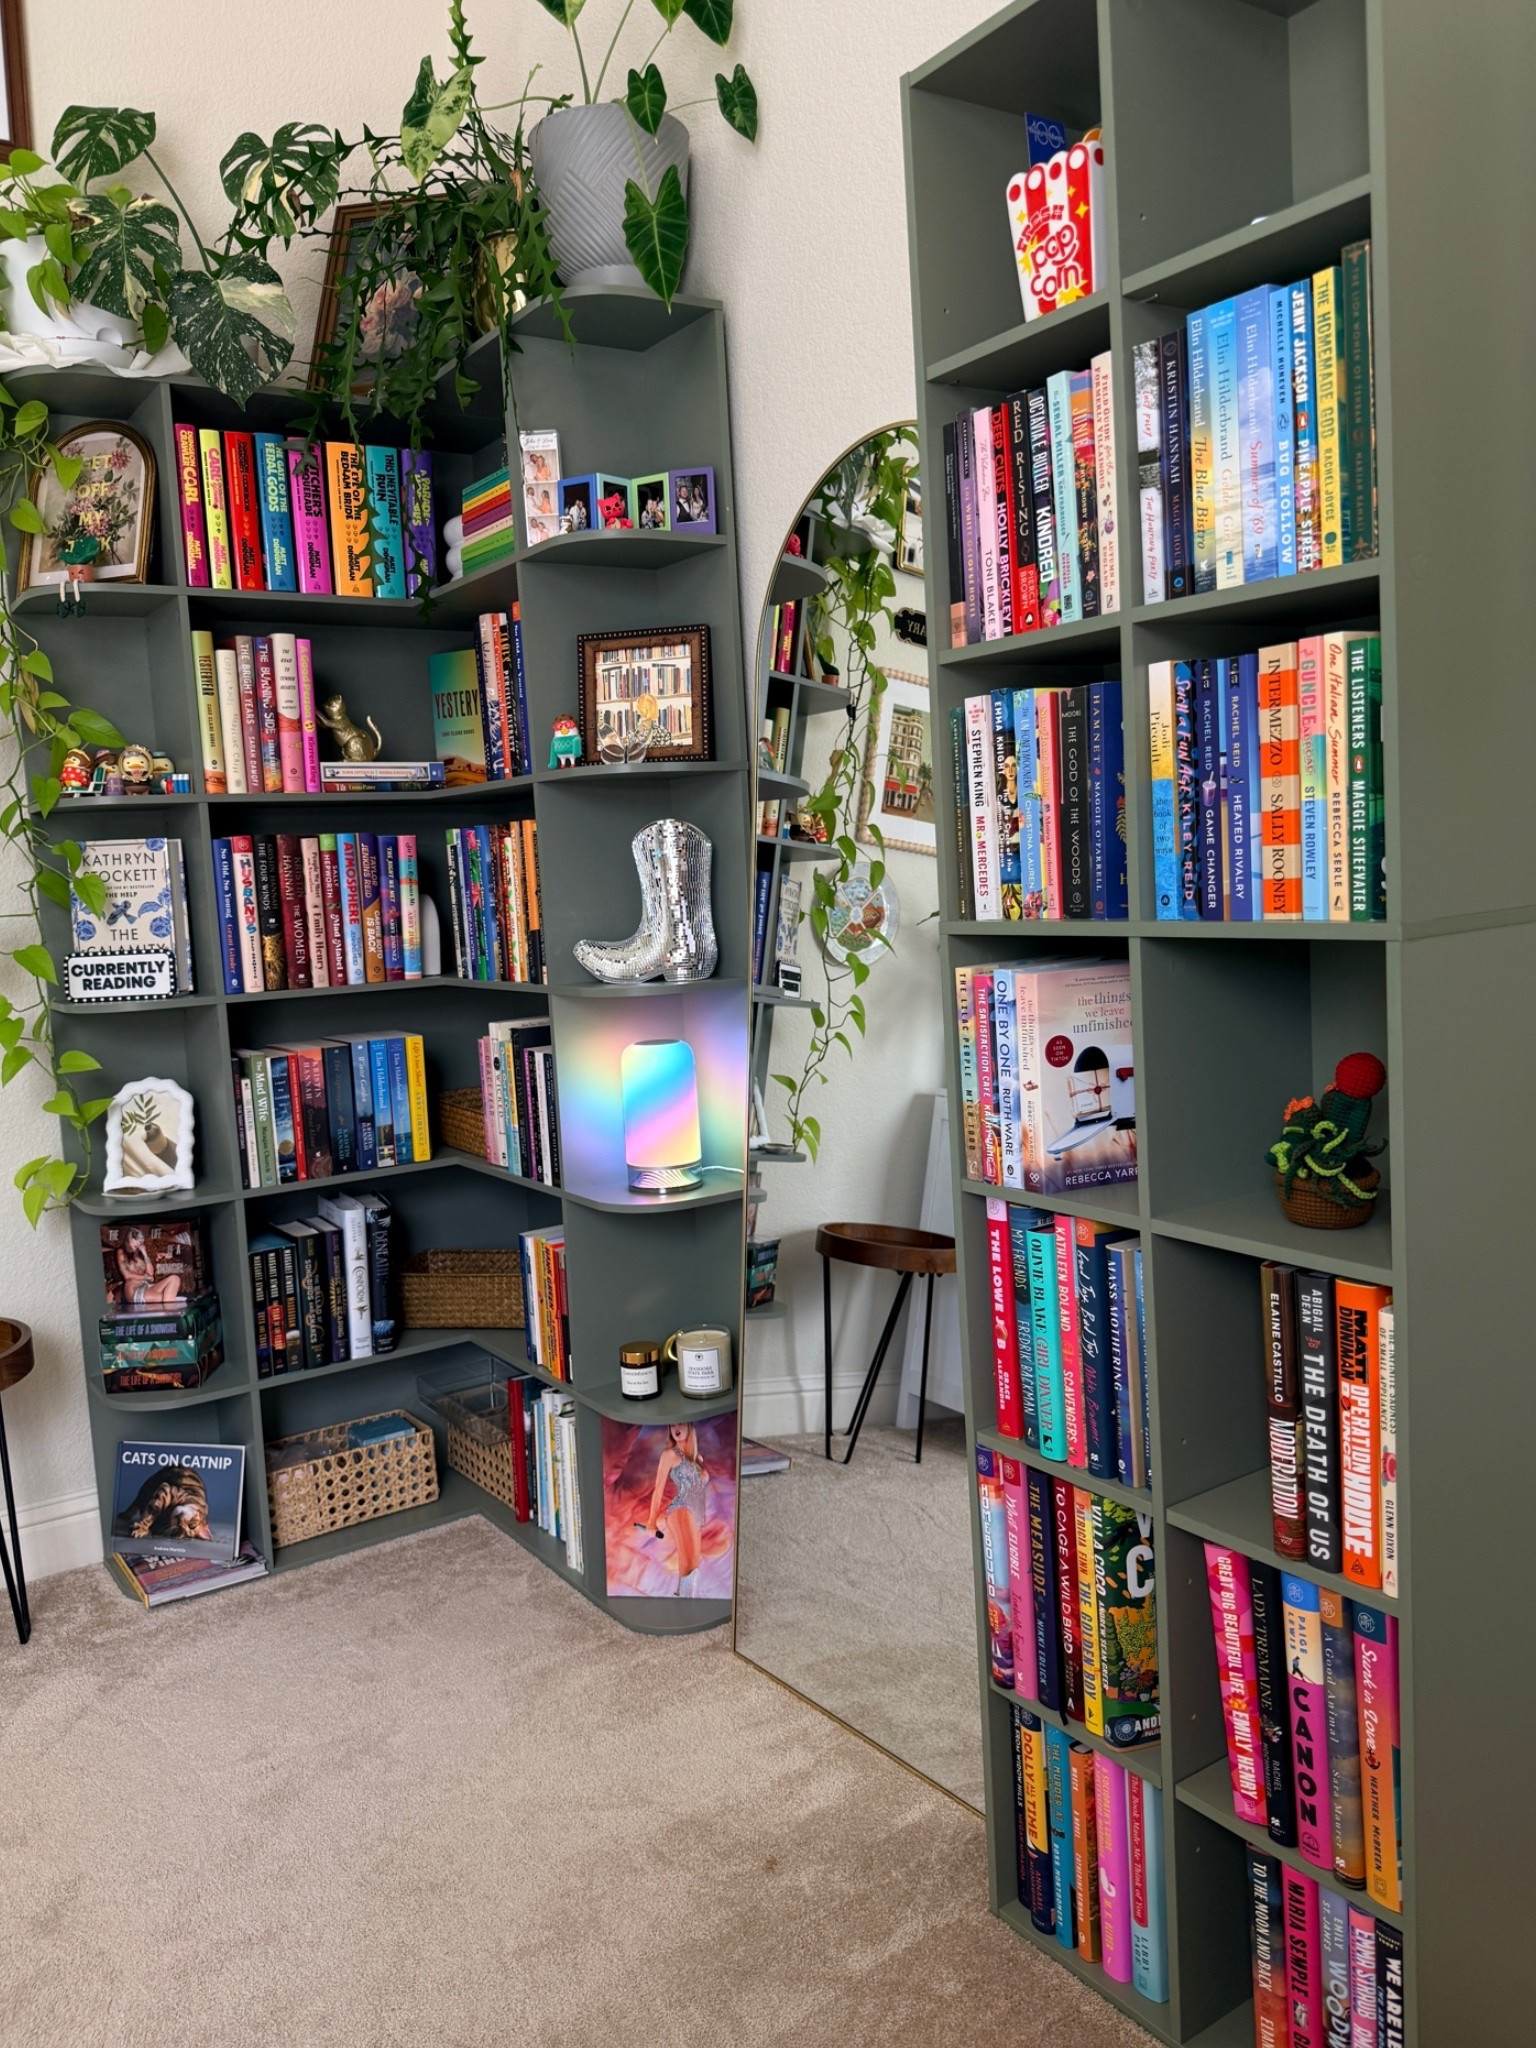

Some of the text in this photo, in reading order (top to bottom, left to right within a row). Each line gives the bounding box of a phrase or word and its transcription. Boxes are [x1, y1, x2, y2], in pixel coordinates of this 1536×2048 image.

[1017, 204, 1065, 252] FRESH
[1030, 224, 1076, 273] pop
[1030, 265, 1081, 298] corn
[1315, 280, 1336, 439] THE HOMEMADE GOD
[1166, 360, 1183, 484] KRISTIN HANNAH
[1191, 319, 1209, 550] Elin Hilderbrand The Blue Bistro
[1292, 290, 1312, 572] JENNY JACKSON PINEAPPLE STREET
[77, 482, 112, 499] OFF
[183, 466, 198, 506] CARL
[264, 442, 279, 513] FERAL GODS
[344, 490, 354, 521] BRIDE
[374, 473, 386, 502] RUIN
[1012, 400, 1029, 537] RED RISING
[1279, 440, 1293, 564] BUG HOLLOW
[65, 536, 112, 553] JK
[78, 510, 105, 526] MY
[991, 412, 1012, 623] DEEP CUTS HOLLY BRICKLEY
[1036, 508, 1054, 583] KINDRED
[985, 549, 995, 625] TONI BLAKE
[1019, 571, 1028, 610] BROWN
[1026, 570, 1035, 606] PIERCE
[240, 643, 255, 726] THE BRIGHT YEARS
[1231, 695, 1240, 768] RACHEL REID
[1327, 643, 1342, 888] One Italian Summer REBECCA SERLE
[971, 729, 989, 897] STEPHEN KING MERCEDES
[1067, 726, 1080, 885] THE GOD OF THE WOODS
[1268, 657, 1286, 914] INTERMEZZO SALLY ROONEY
[1351, 648, 1367, 912] THE LISTENERS MAGGIE STIEFVATER
[82, 852, 156, 867] KATHRYN
[1025, 800, 1035, 889] CHRISTINA LAUREN
[1205, 809, 1217, 909] GAME CHANGER
[1233, 795, 1245, 900] HEATED RIVALRY
[1304, 786, 1316, 880] STEVEN ROWLEY
[258, 842, 269, 912] THE FOUR WINDS
[342, 841, 360, 926] ATMOSPHERE
[70, 960, 166, 977] CURRENTLY
[110, 928, 139, 941] THE
[294, 919, 306, 965] WOMEN
[313, 913, 324, 971] Emily Henry
[82, 975, 156, 991] READING
[1077, 991, 1131, 1007] the things
[1085, 1007, 1125, 1018] we leave
[254, 1072, 267, 1122] Mad Wife
[996, 980, 1014, 1157] ONE BY ONE RUTH WARE
[1065, 1170, 1112, 1186] REBECCA
[989, 1229, 1004, 1313] THE LOWE
[1012, 1229, 1027, 1289] MY FRIENDS
[1030, 1238, 1047, 1334] OLIVIE BLAKE
[1054, 1226, 1079, 1444] KATHLEEN BOLAND SCAVENGERS
[1301, 1294, 1311, 1324] DEAN
[1312, 1289, 1324, 1333] ABIGAIL
[1339, 1306, 1354, 1381] DINNIMAN
[1353, 1309, 1369, 1384] MATT
[1269, 1292, 1298, 1520] ELAINE CASTILLO MODERATION
[122, 1451, 233, 1470] CATS ON CATNIP
[1303, 1354, 1330, 1561] THE DEATH OF US
[1343, 1384, 1372, 1558] OPERATION HOUSE
[1030, 1481, 1046, 1596] THE MEASURE
[1056, 1486, 1074, 1655] TO CAGE WILD BIRD
[1092, 1504, 1107, 1597] VILLA COCO
[1217, 1556, 1232, 1590] GREAT
[1221, 1591, 1235, 1610] BIG
[1080, 1582, 1097, 1701] THE GOLDEN BOY
[1222, 1612, 1241, 1670] BEAUTIFUL
[1231, 1709, 1252, 1752] EMILY
[1292, 1686, 1318, 1828] CANON
[1023, 1733, 1039, 1840] DOLLY TIME
[1235, 1753, 1256, 1800] HENRY
[1252, 1861, 1272, 1992] TO THE MOON AND BACK
[1287, 1879, 1308, 1997] MARIA SEMPLE
